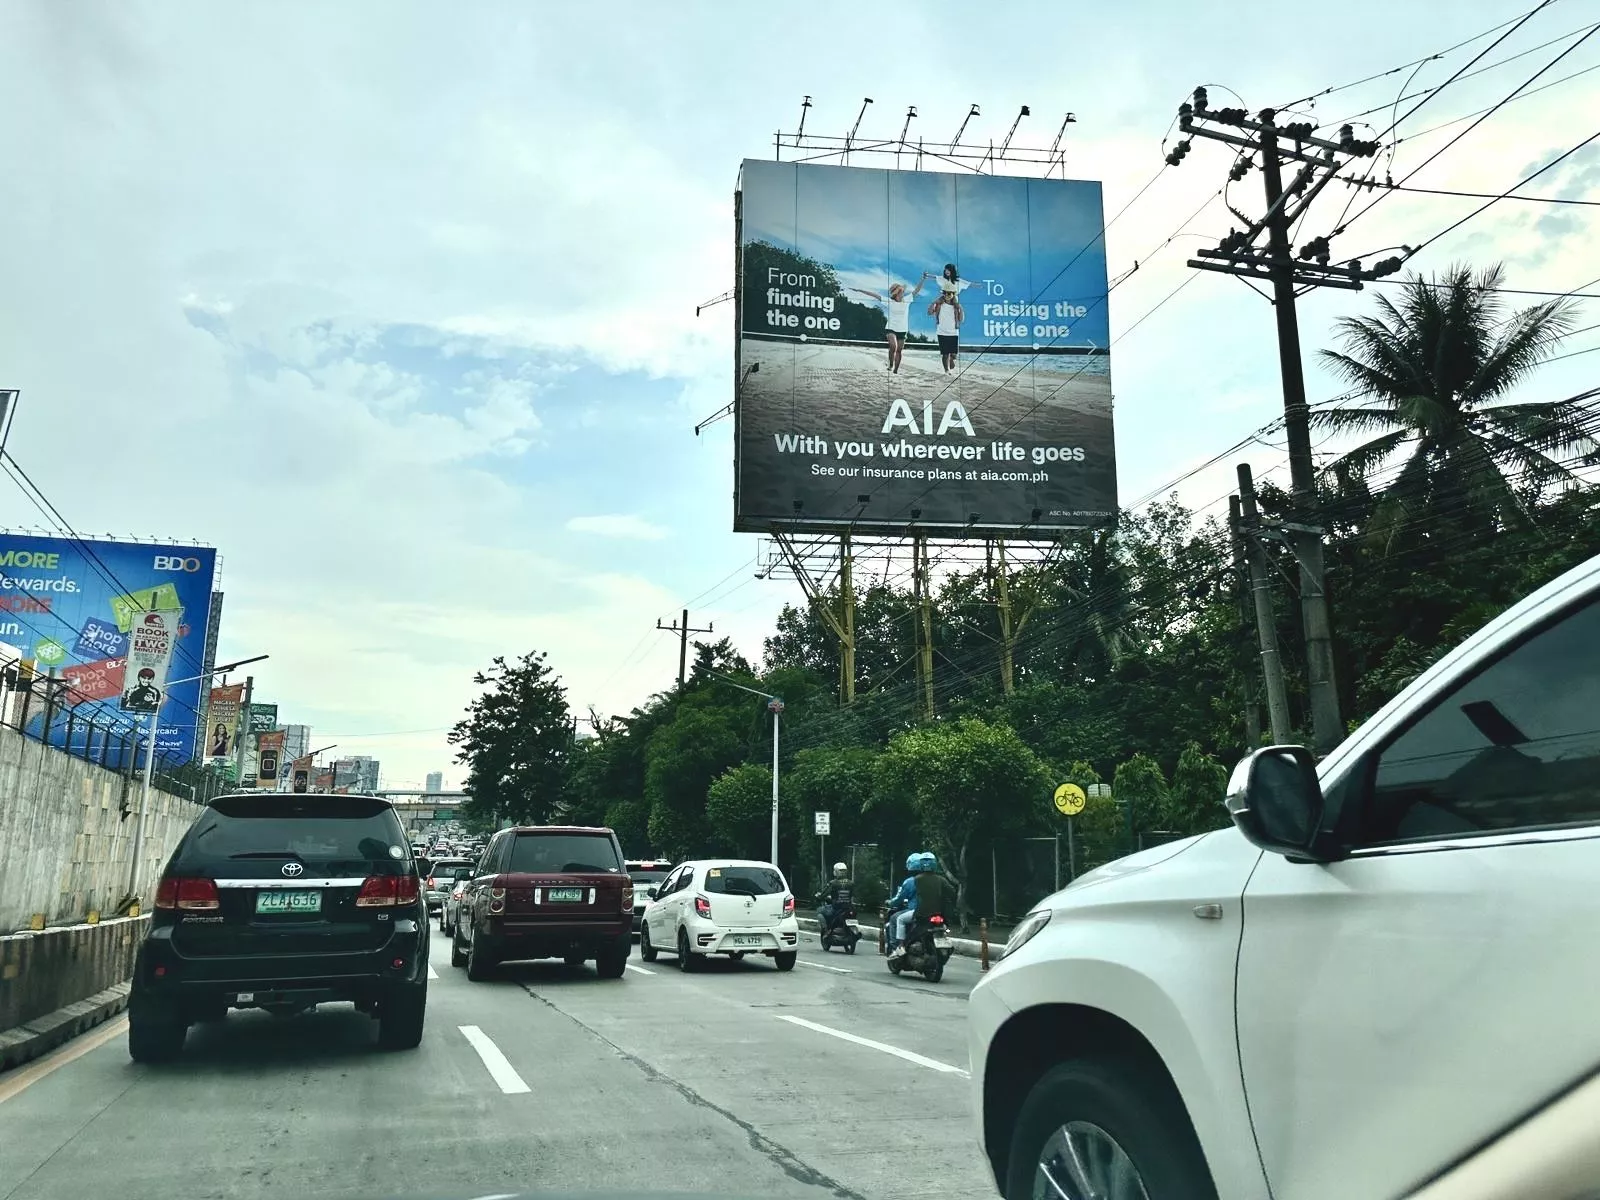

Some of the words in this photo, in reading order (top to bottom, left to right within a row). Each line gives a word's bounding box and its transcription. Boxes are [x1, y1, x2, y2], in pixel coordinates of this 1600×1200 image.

[768, 267, 816, 287] From
[983, 279, 1004, 296] To
[766, 287, 835, 313] finding
[983, 300, 1049, 320] raising
[1055, 301, 1087, 318] the
[766, 309, 799, 327] the
[804, 316, 840, 330] one
[983, 320, 1028, 337] little
[1033, 325, 1070, 338] one
[881, 399, 976, 436] AIA
[774, 433, 828, 455] With
[834, 441, 874, 459] you
[881, 439, 985, 460] wherever
[991, 442, 1025, 461] life
[1032, 446, 1085, 465] goes
[811, 464, 835, 476] See
[838, 467, 859, 477] our
[863, 466, 924, 479] insurance
[928, 468, 962, 481] plans
[965, 470, 977, 480] at
[980, 470, 1049, 483] aia.com.ph
[153, 555, 201, 572] BDO
[0, 573, 81, 593] ewards.
[88, 623, 123, 645] Shop
[136, 627, 169, 638] BOOK
[136, 639, 168, 649] TWO
